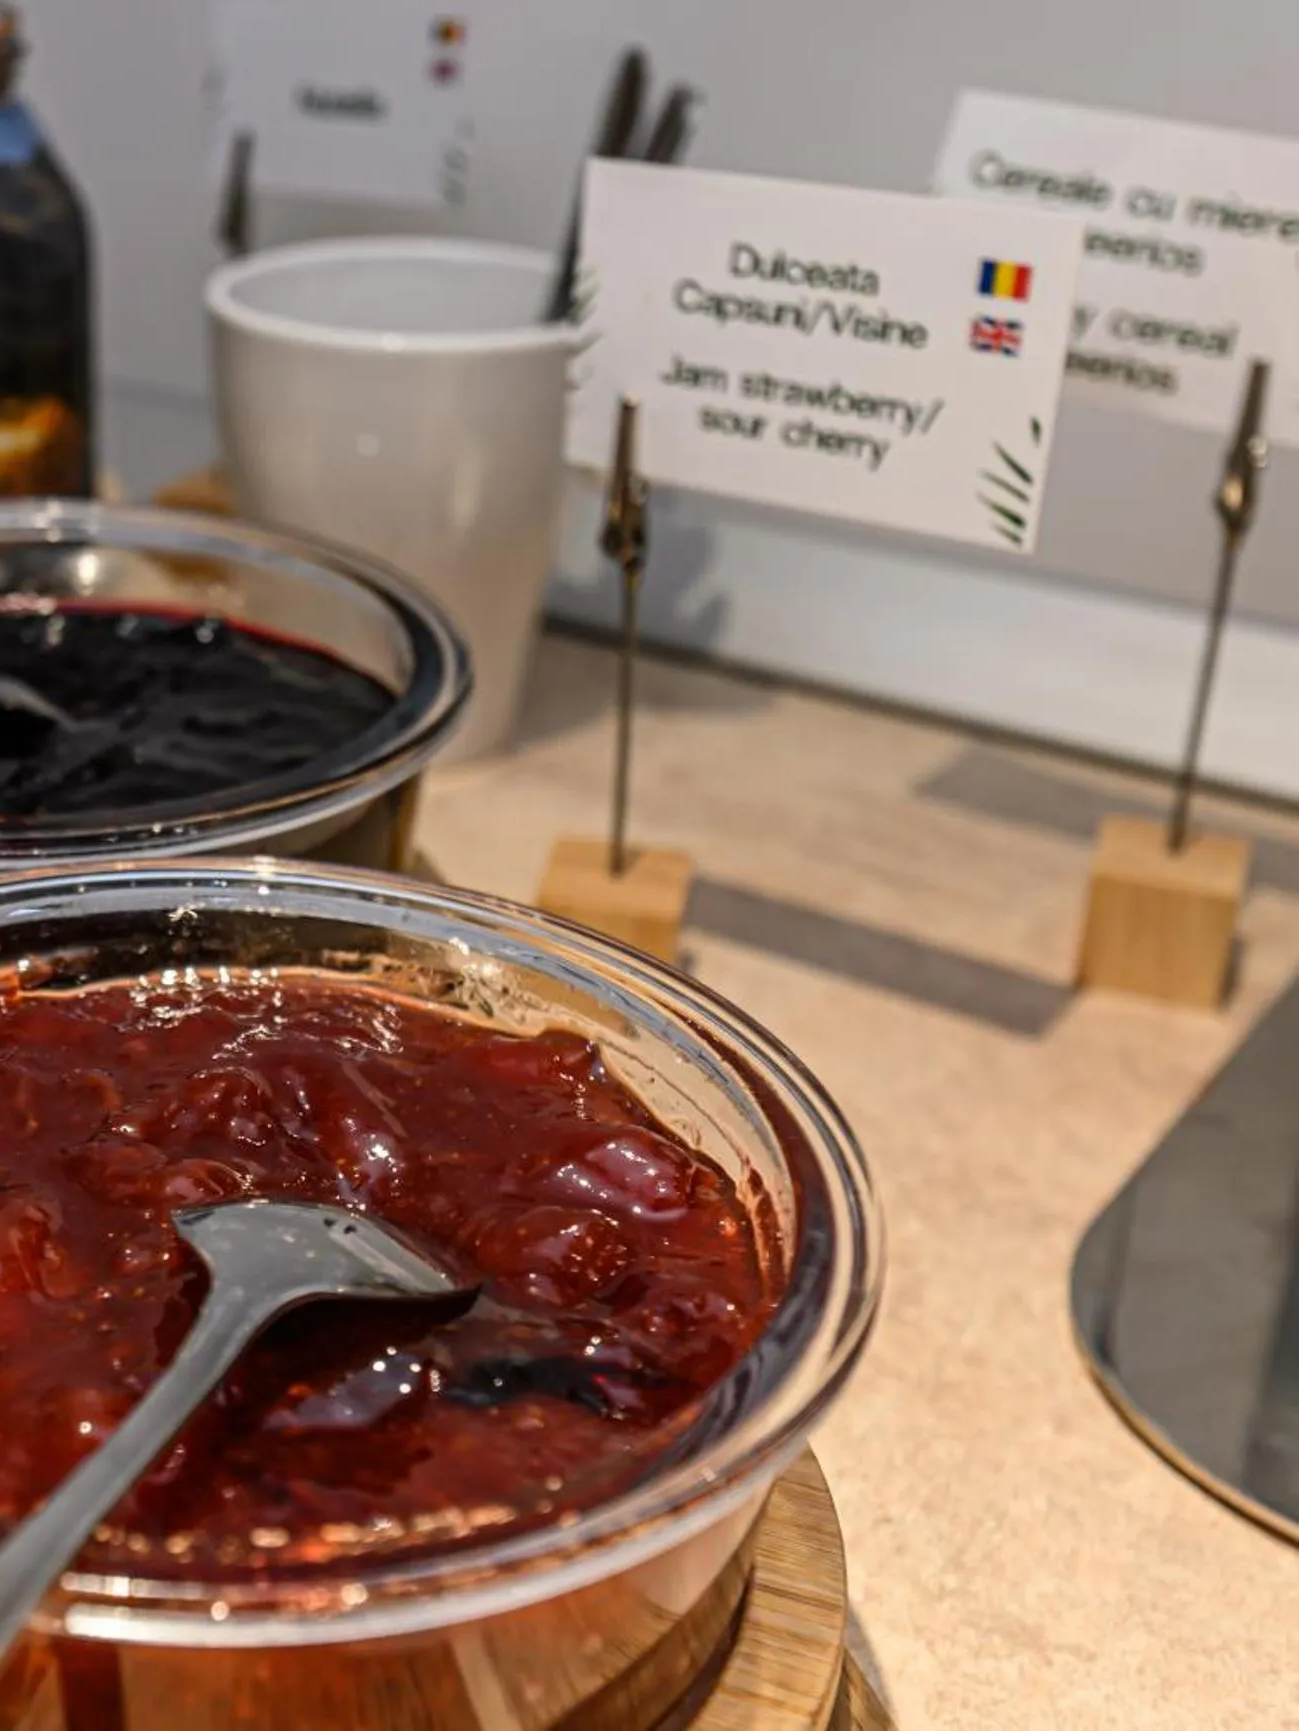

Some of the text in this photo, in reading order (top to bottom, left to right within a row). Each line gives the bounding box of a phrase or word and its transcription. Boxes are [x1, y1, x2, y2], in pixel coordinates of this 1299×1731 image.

[730, 241, 881, 297] Dulceata
[1084, 226, 1204, 276] eerios
[673, 278, 929, 350] Capsuni/Visine
[659, 356, 946, 437] Jam strawberry/
[1066, 350, 1178, 395] eerios
[699, 405, 891, 473] sour cherry
